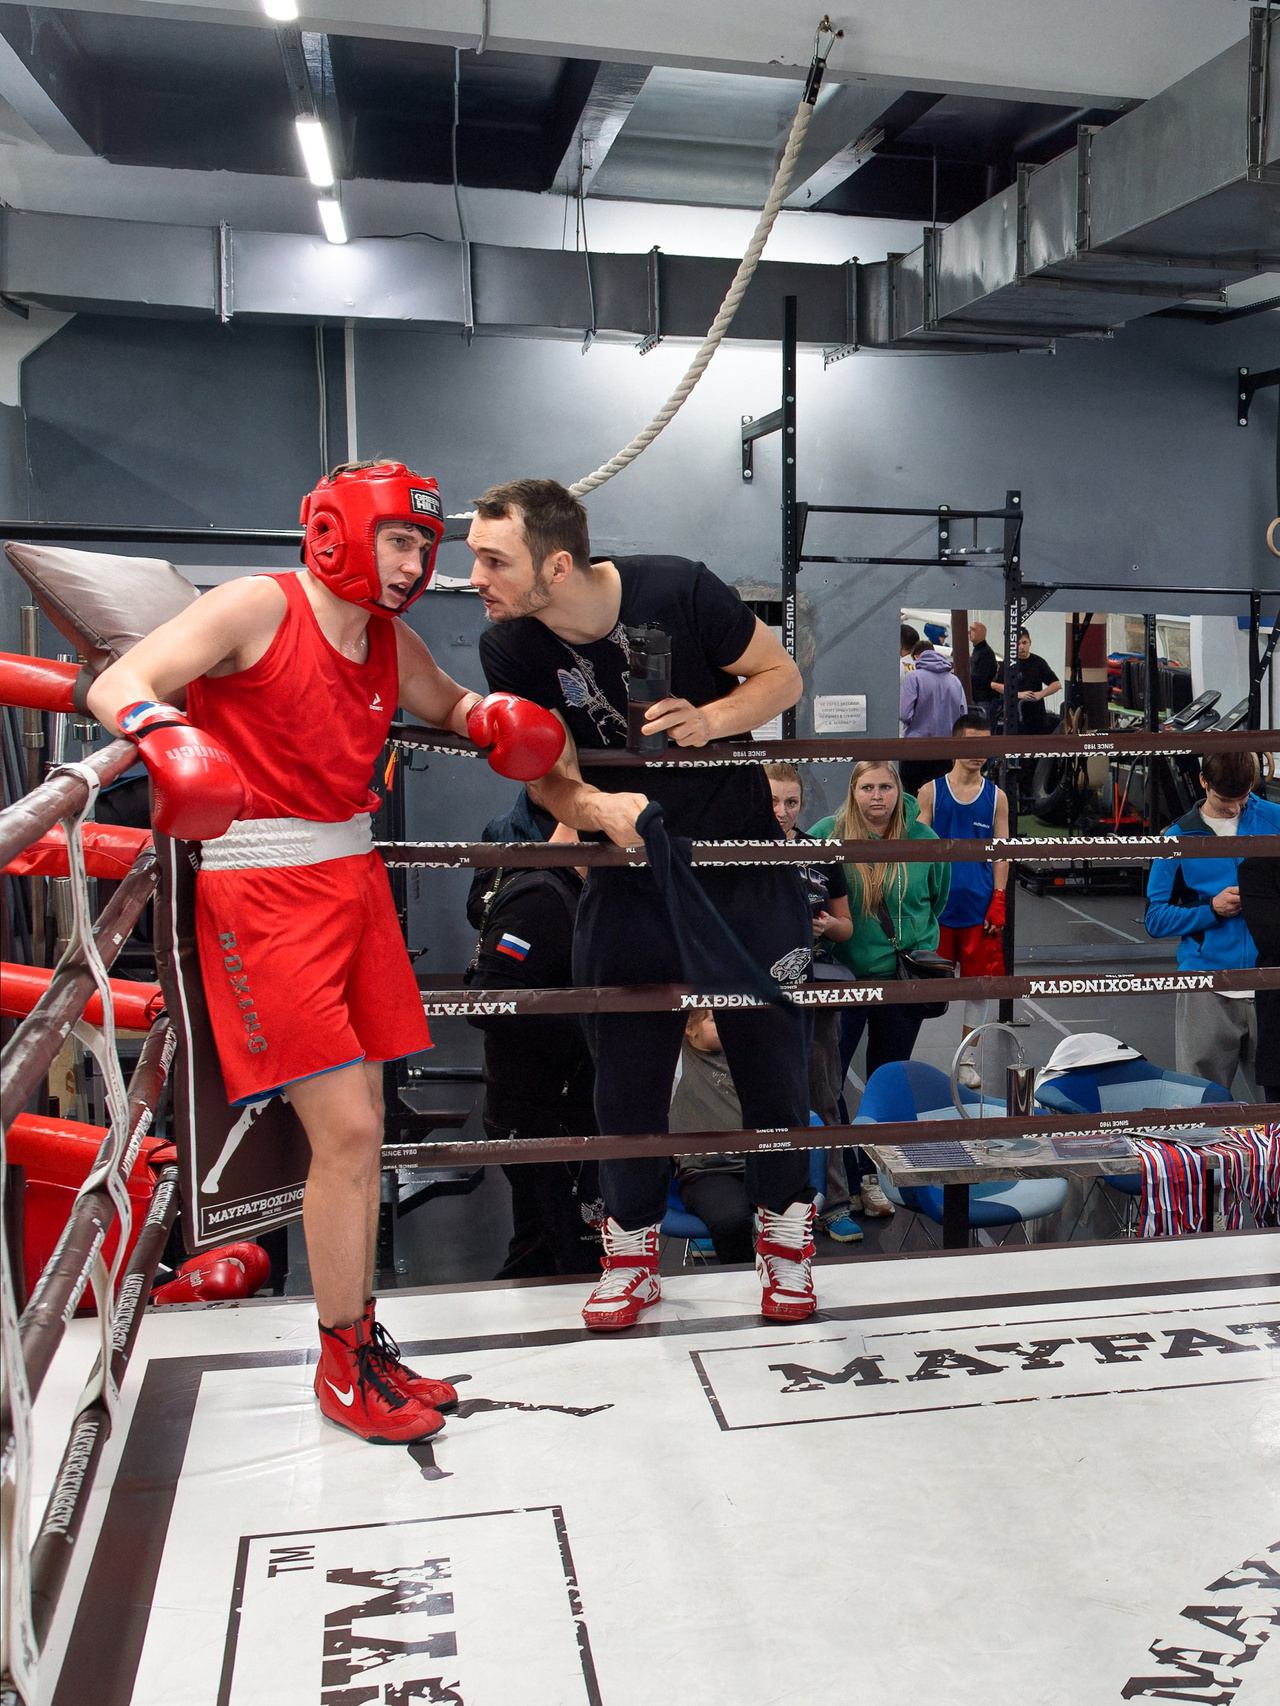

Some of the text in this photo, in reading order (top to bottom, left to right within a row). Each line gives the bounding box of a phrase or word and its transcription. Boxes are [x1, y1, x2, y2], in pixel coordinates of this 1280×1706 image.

[786, 594, 794, 659] YOUSTEE
[1009, 600, 1018, 667] YOUSTEEL
[219, 931, 269, 1054] BOXING
[1029, 975, 1214, 996] MAYFATBOXINGGYM
[267, 1545, 316, 1579] TM
